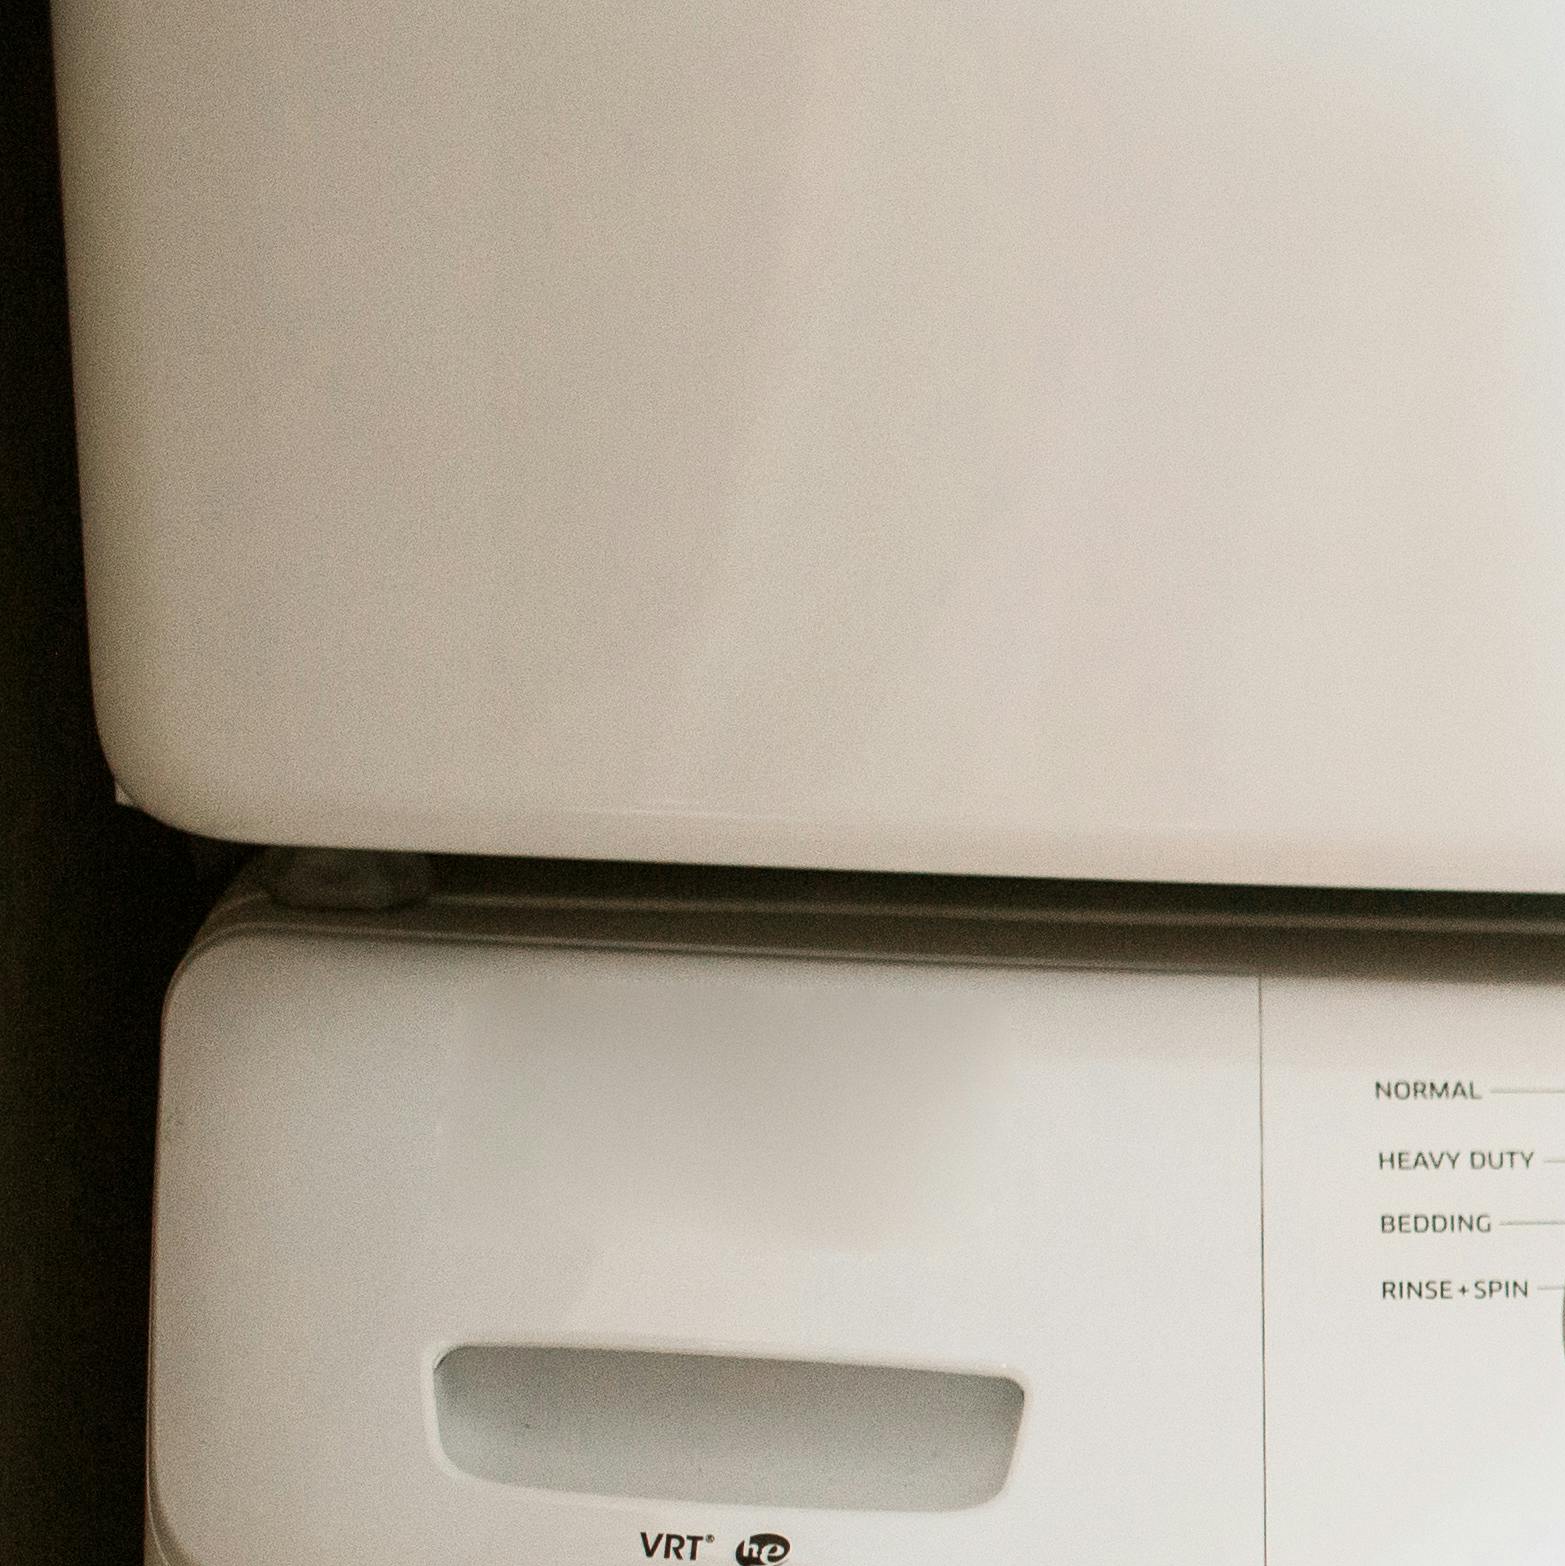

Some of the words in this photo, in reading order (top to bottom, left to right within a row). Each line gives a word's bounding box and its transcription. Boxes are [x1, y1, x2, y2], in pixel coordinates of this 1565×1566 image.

[1375, 1081, 1483, 1100] NORMAL
[1378, 1151, 1461, 1171] HEAVY
[1469, 1151, 1535, 1171] DUTY
[1380, 1213, 1492, 1234] BEDDING
